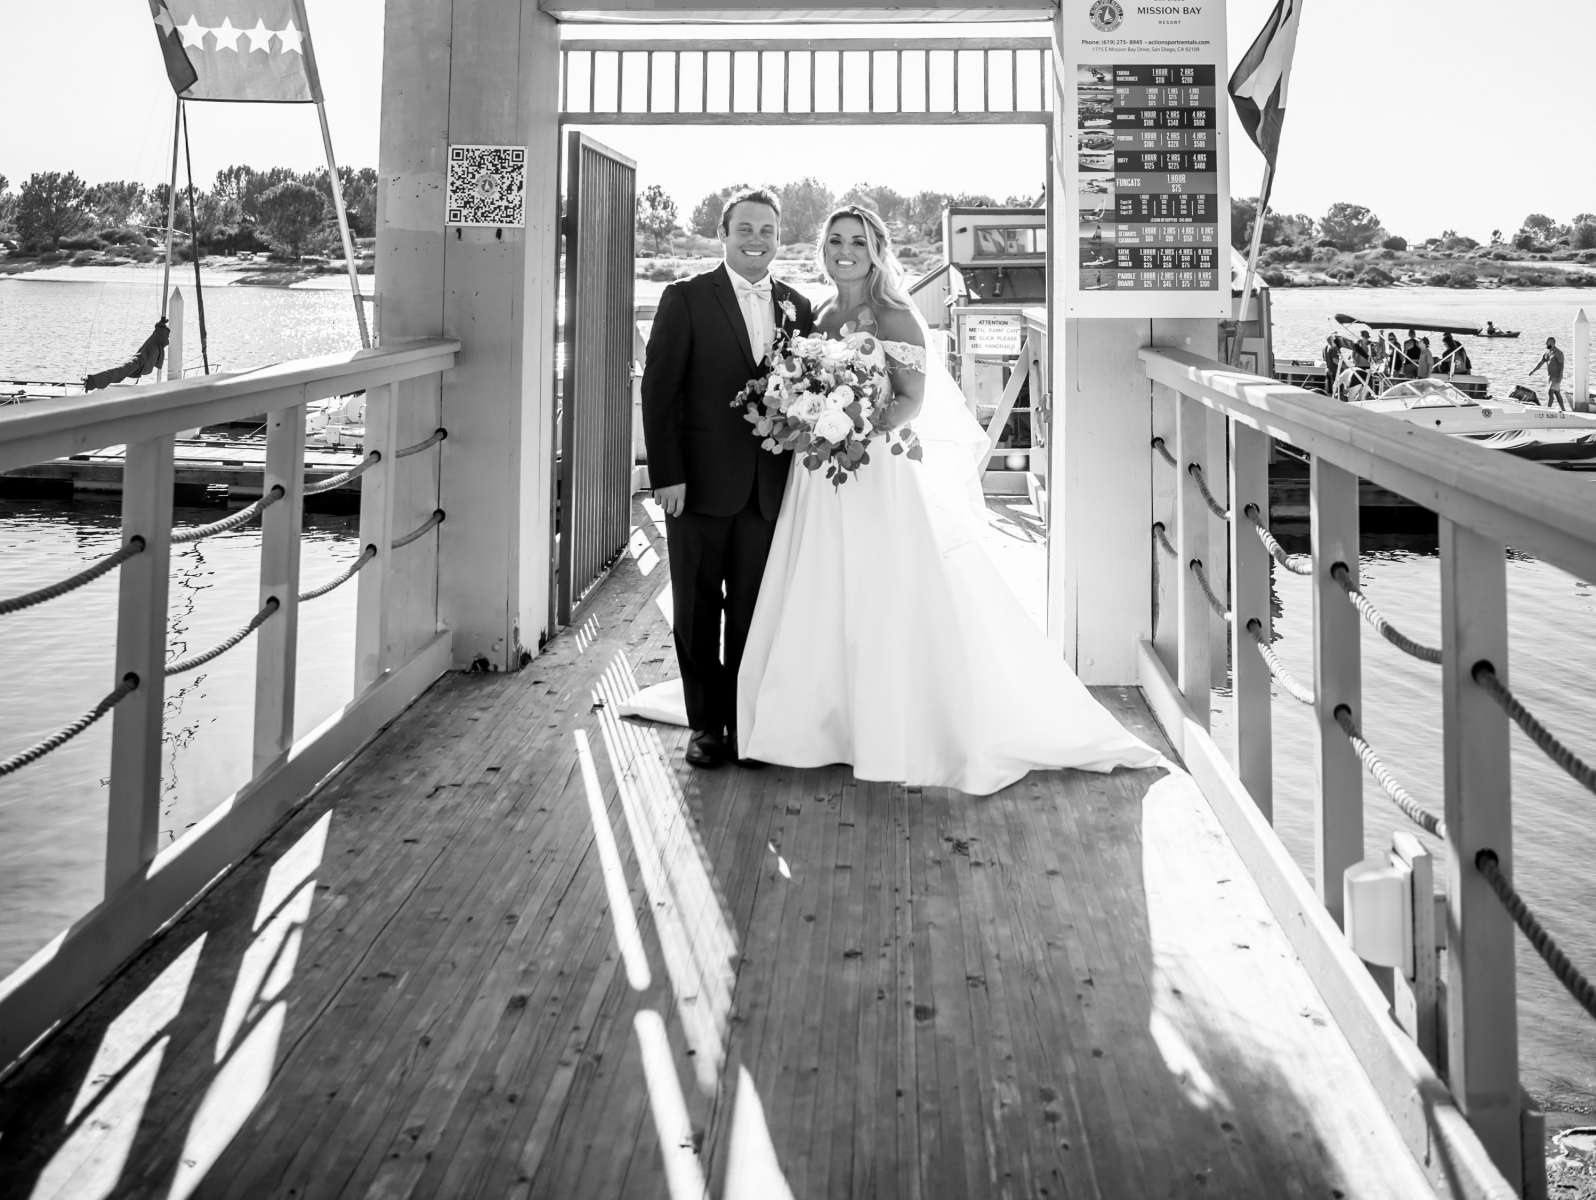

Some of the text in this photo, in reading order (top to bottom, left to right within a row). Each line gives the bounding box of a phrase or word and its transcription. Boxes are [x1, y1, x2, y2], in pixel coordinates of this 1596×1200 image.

[1137, 6, 1202, 15] MISSION BAY
[1116, 178, 1141, 187] FUNCATS
[1170, 174, 1186, 183] HOUR
[1171, 184, 1182, 192] $75
